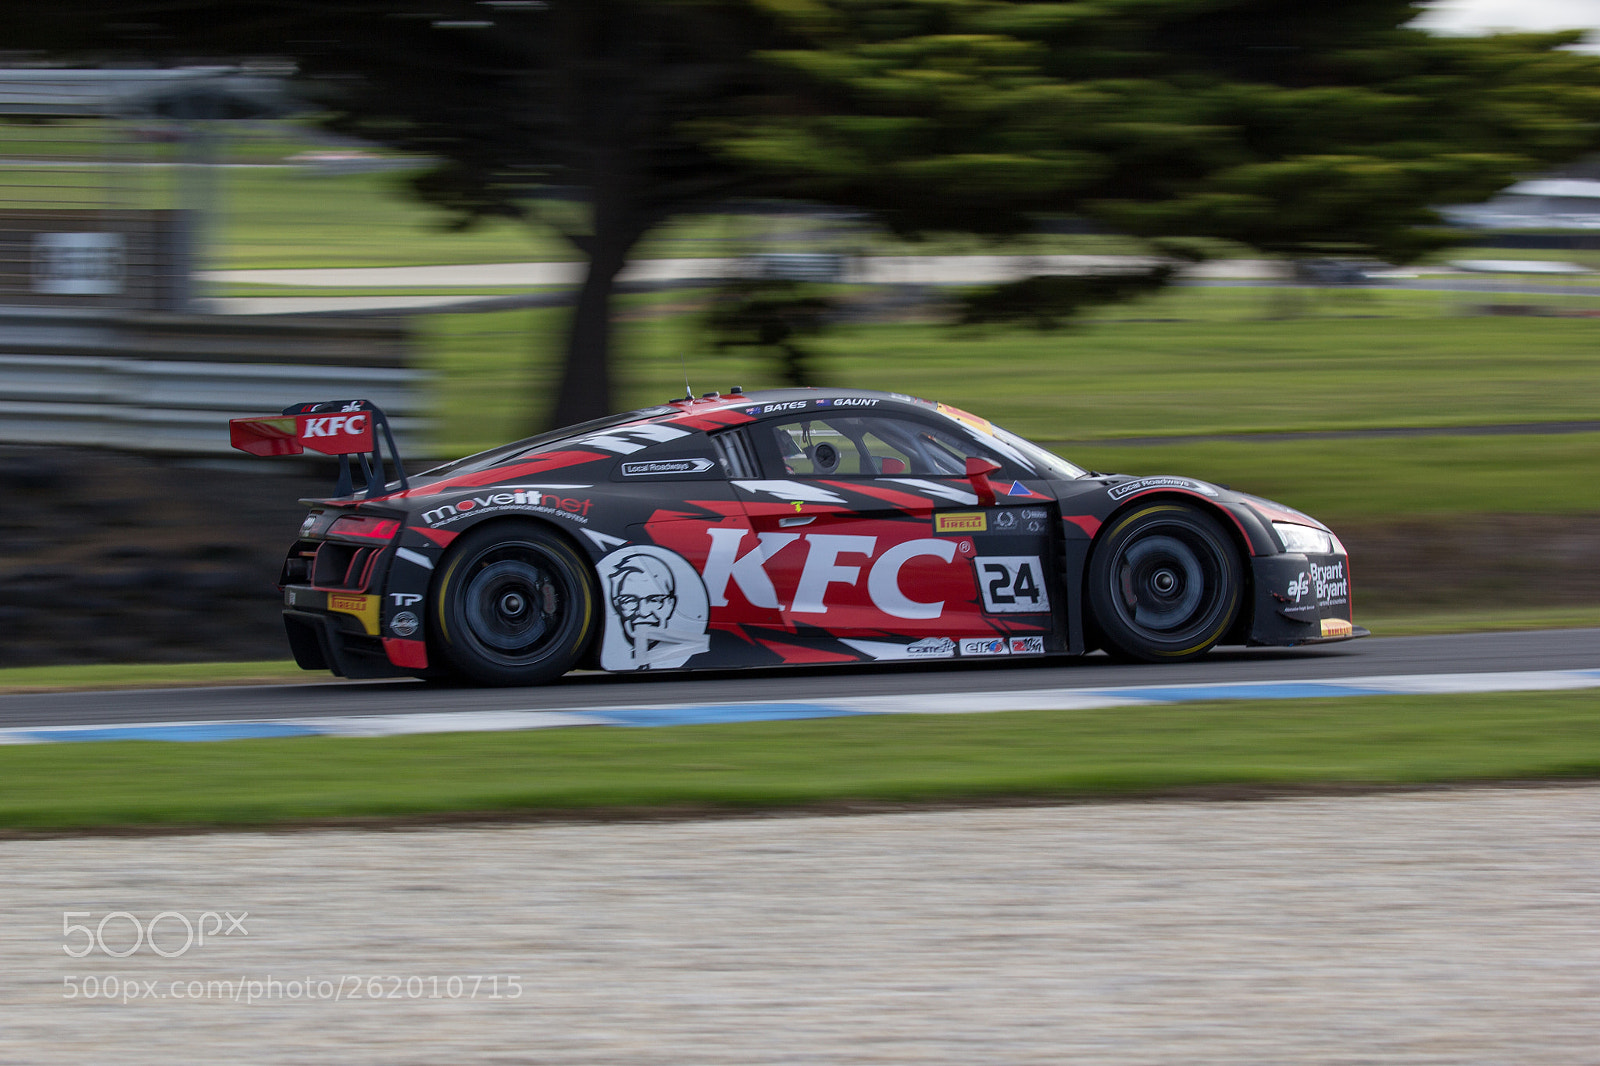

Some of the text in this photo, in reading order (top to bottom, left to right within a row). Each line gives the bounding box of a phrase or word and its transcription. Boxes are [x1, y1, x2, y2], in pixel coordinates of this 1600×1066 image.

[763, 401, 808, 414] BATES
[302, 415, 366, 439] KFC
[628, 463, 689, 473] Local Roadways
[1115, 478, 1190, 496] Local Roadways
[555, 509, 588, 524] SYSTEM
[940, 516, 982, 529] PIRELLI
[702, 527, 958, 620] KFC
[1310, 561, 1343, 584] Bryant
[983, 563, 1040, 604] 24
[1287, 572, 1309, 603] afs
[1316, 578, 1348, 601] Bryant
[331, 594, 367, 611] PIRELLI
[389, 593, 424, 606] TP
[965, 640, 991, 653] elf
